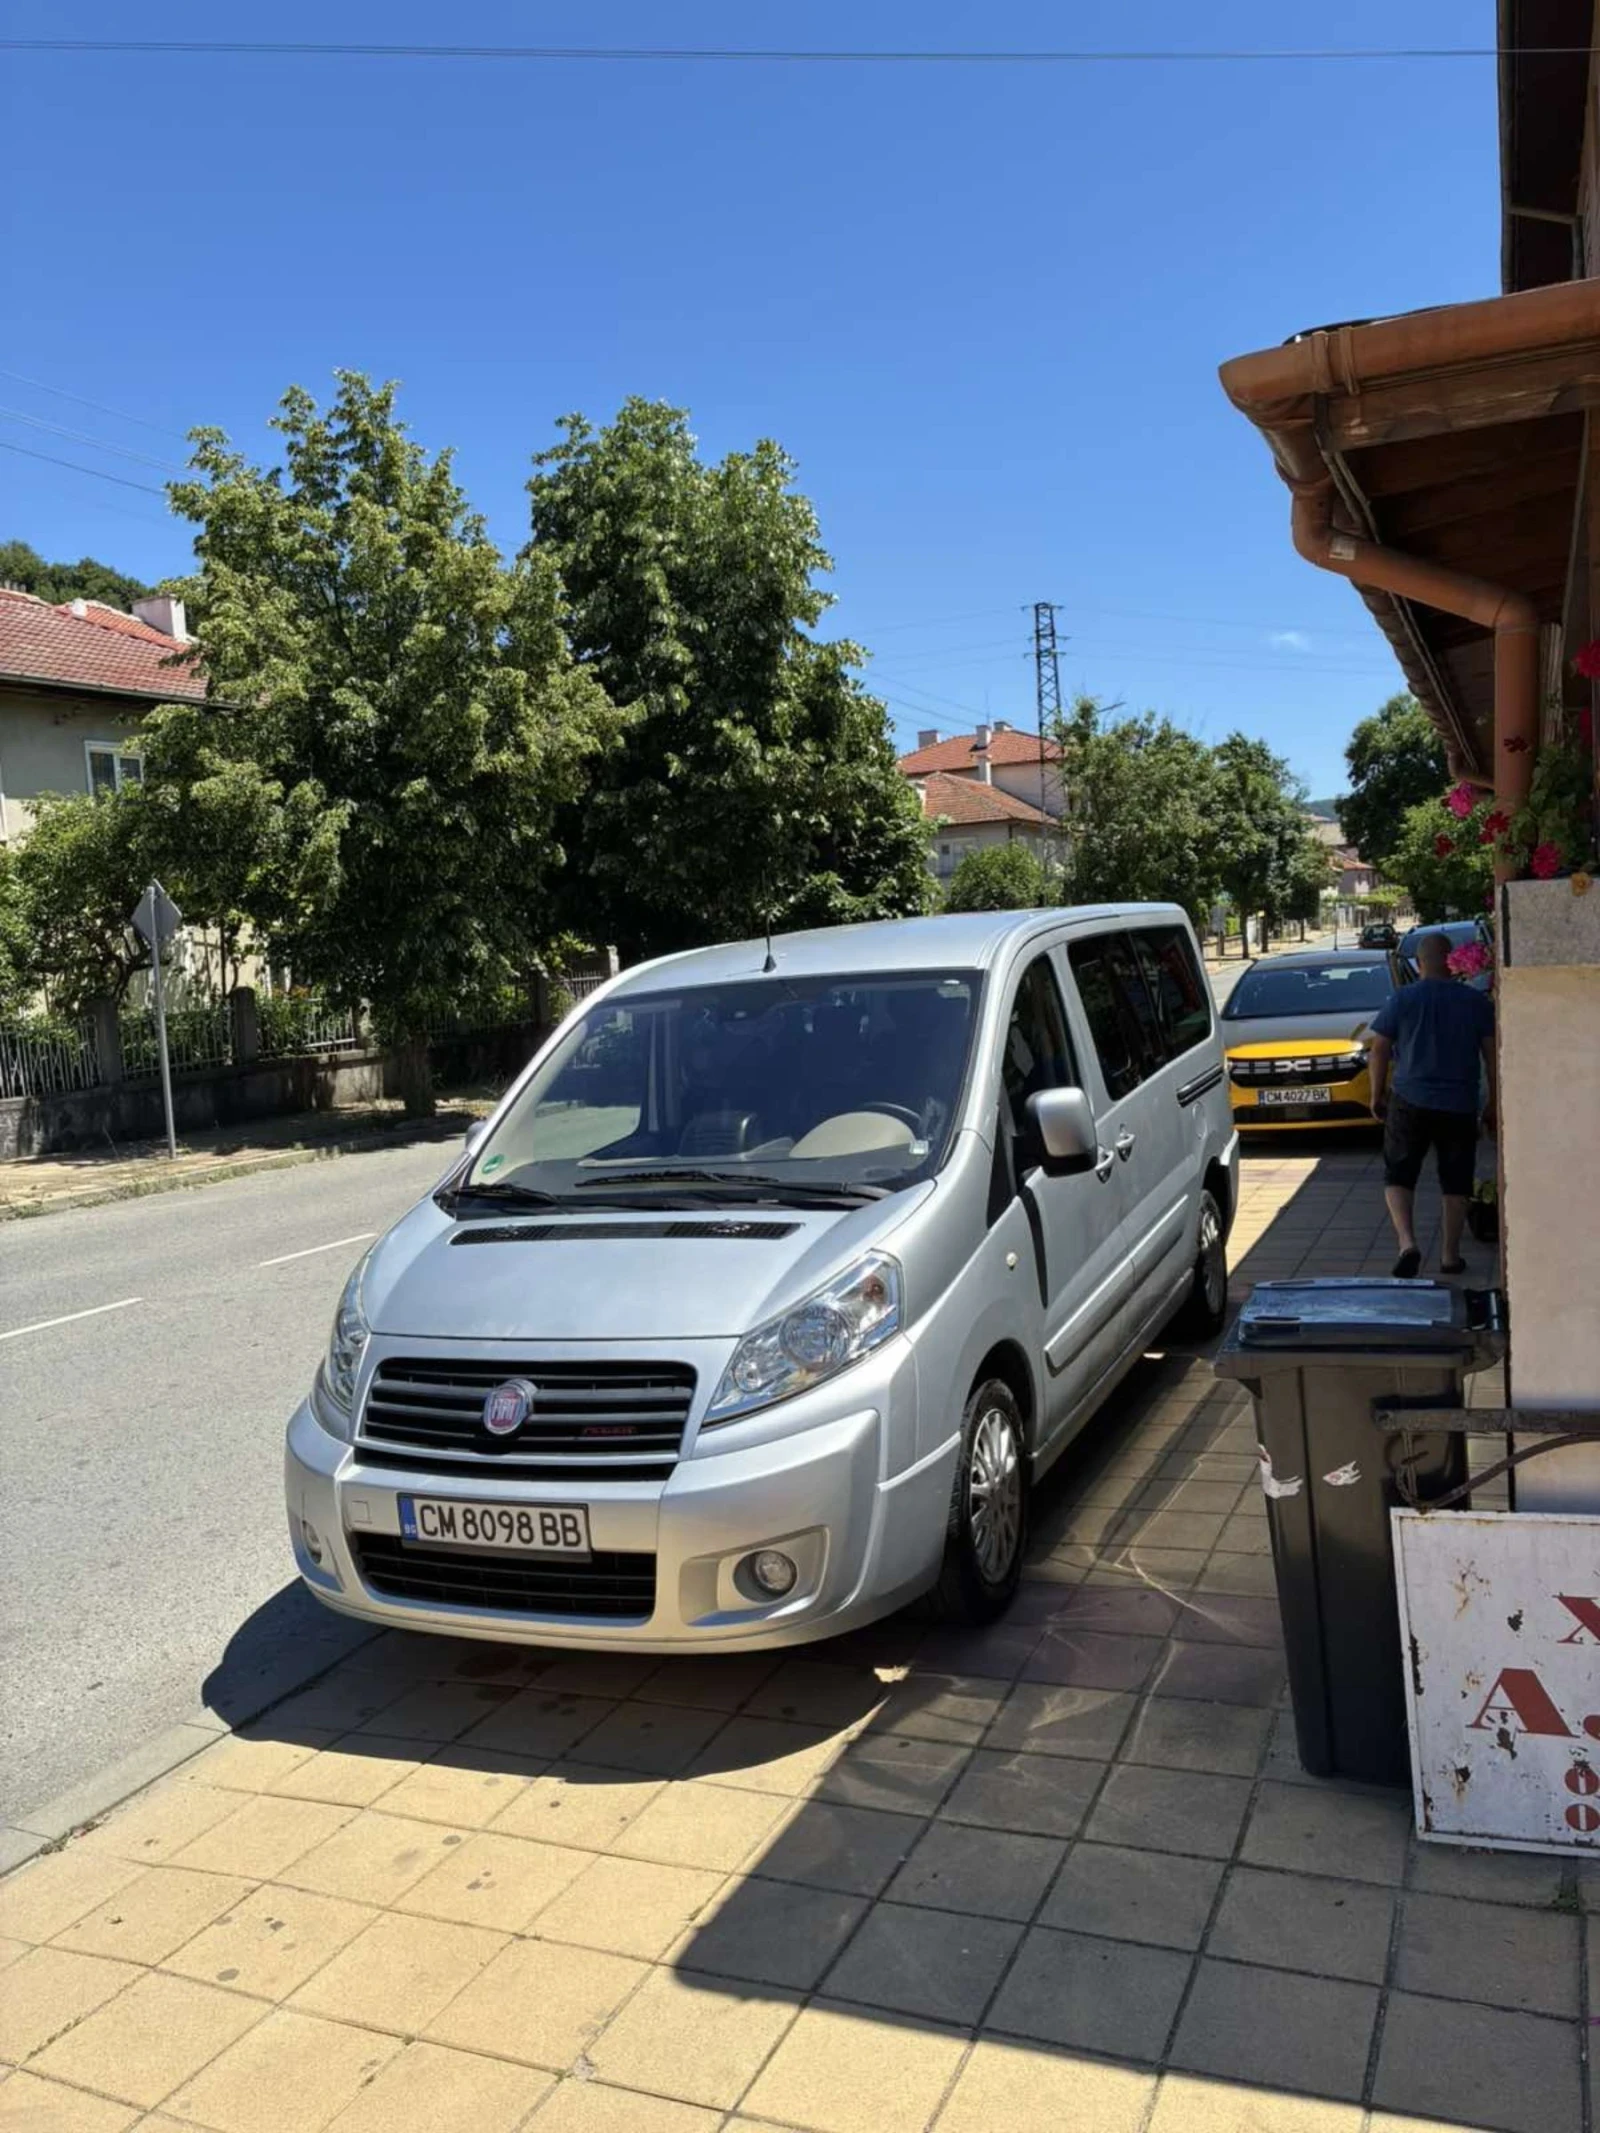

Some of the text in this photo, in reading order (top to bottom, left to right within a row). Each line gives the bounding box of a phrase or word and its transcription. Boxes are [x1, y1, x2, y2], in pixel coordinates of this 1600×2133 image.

[419, 1504, 582, 1548] CM 8098 BB
